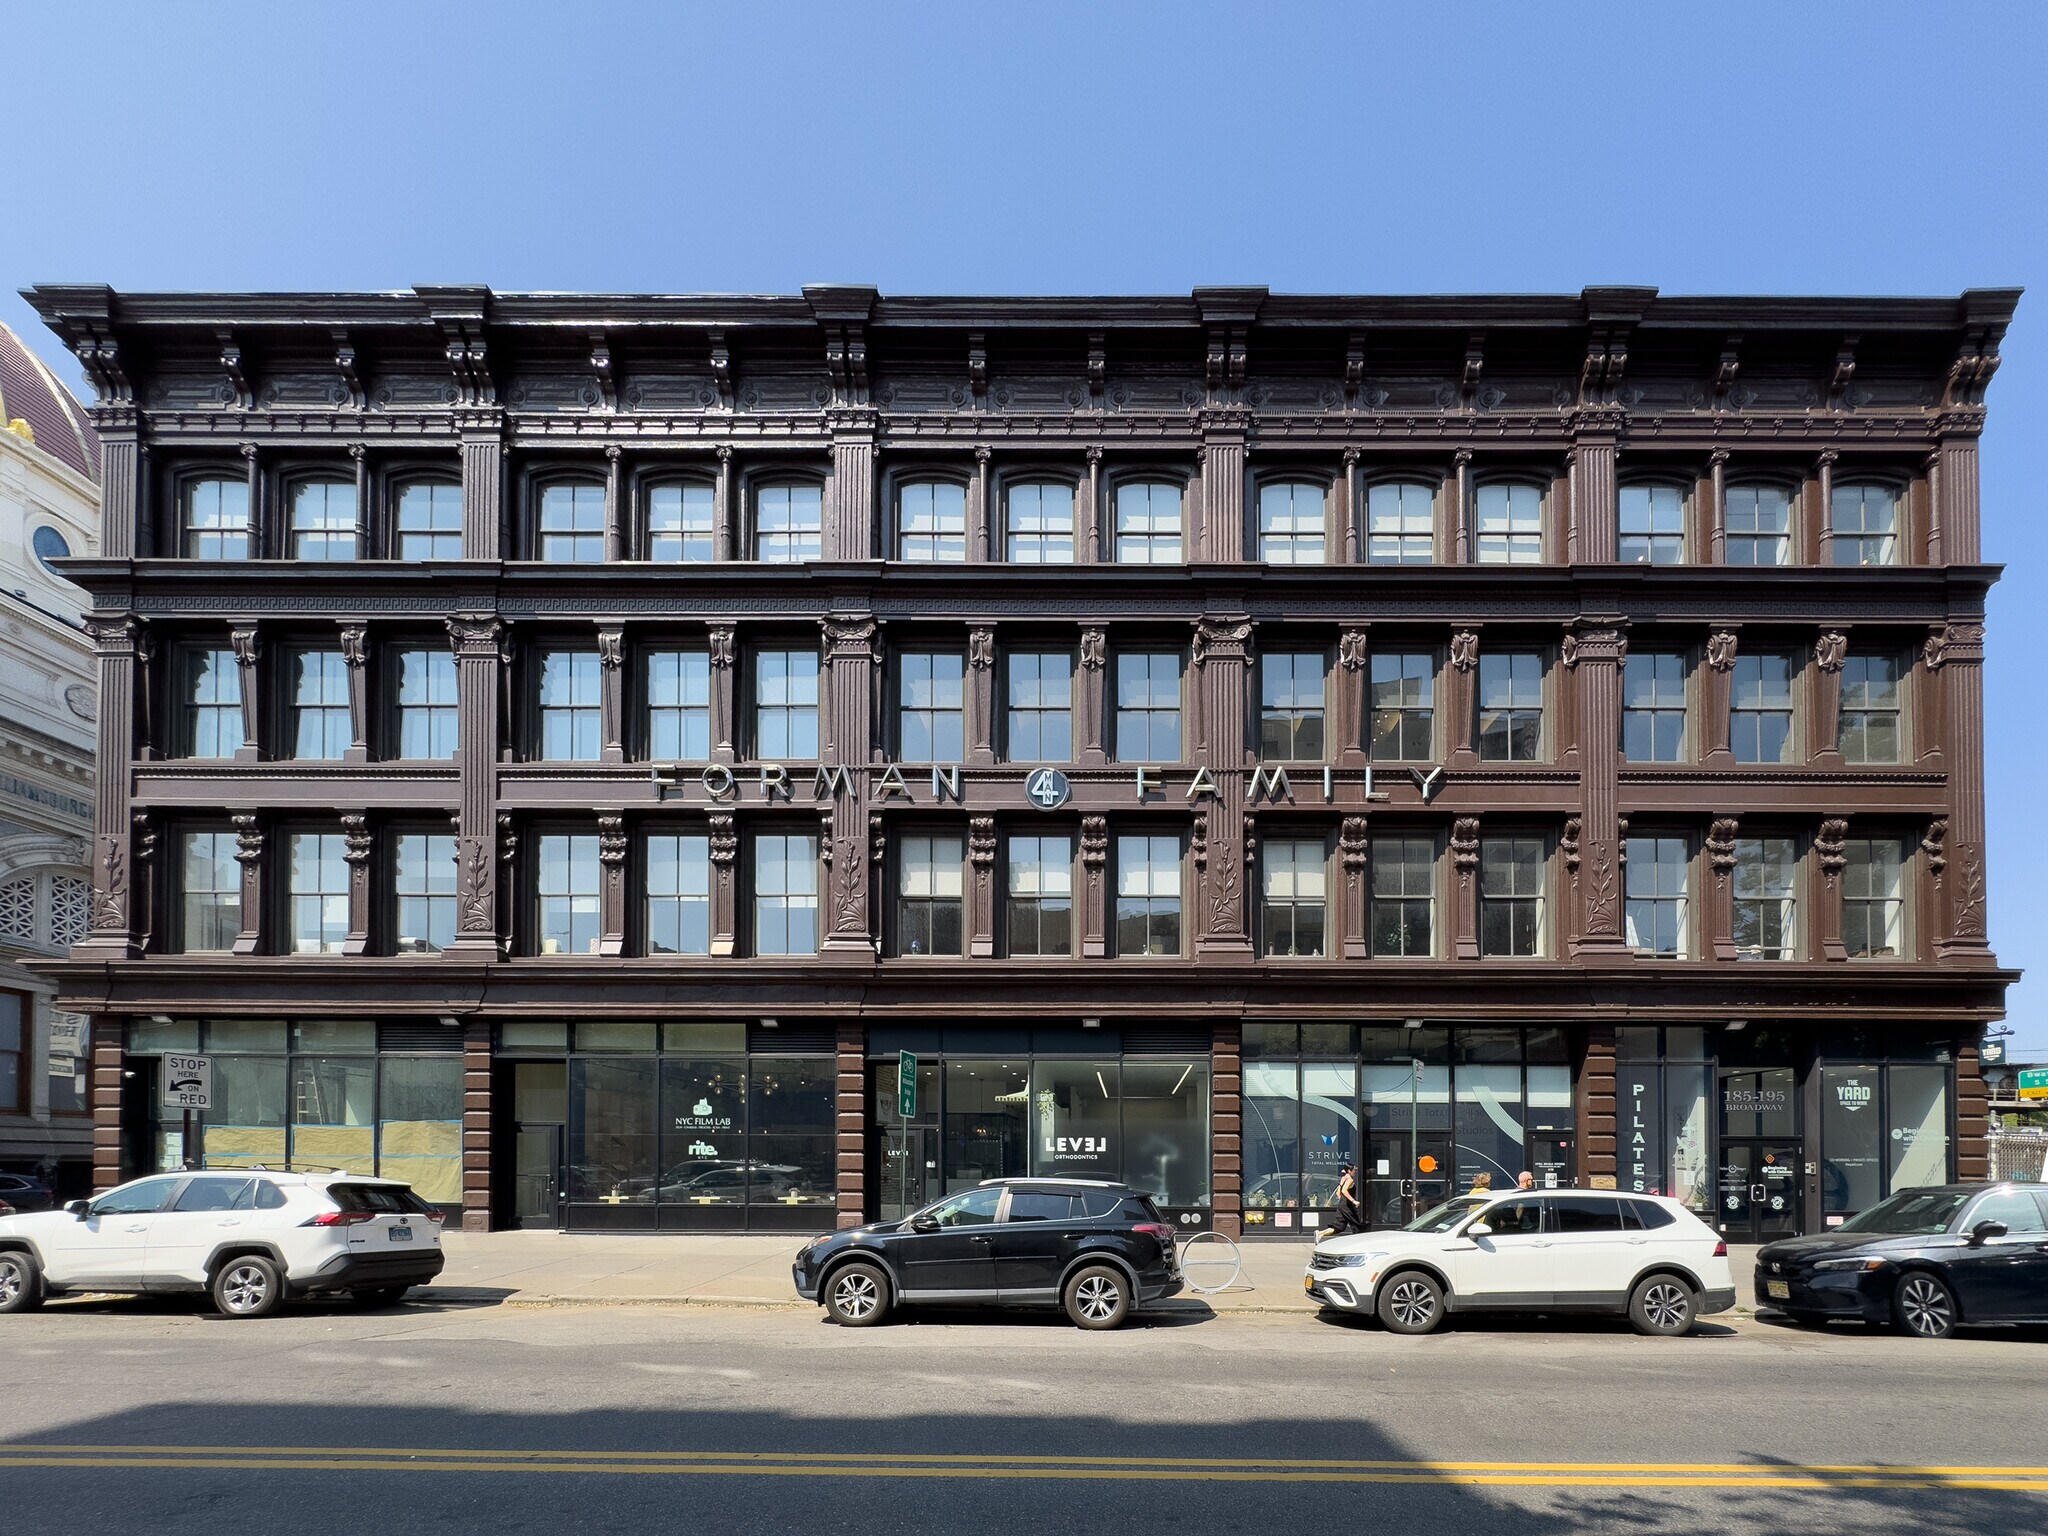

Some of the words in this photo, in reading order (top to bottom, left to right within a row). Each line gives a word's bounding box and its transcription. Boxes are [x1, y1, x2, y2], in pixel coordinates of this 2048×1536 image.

[650, 763, 962, 800] FORMAN
[1136, 765, 1445, 800] FAMILY
[170, 1057, 207, 1070] STOP
[177, 1070, 199, 1079] HERE
[179, 1093, 207, 1105] RED
[1723, 1090, 1786, 1102] 185-195
[1836, 1086, 1871, 1101] YARD
[1725, 1103, 1784, 1111] BROADWAY
[675, 1117, 694, 1126] NYC
[694, 1117, 714, 1126] FILM
[714, 1117, 731, 1126] LAB
[1456, 1127, 1495, 1136] Studios
[1632, 1084, 1646, 1192] PILATES
[688, 1139, 719, 1156] rite.
[1045, 1137, 1107, 1152] LEVEL
[1308, 1151, 1351, 1160] STRIVE
